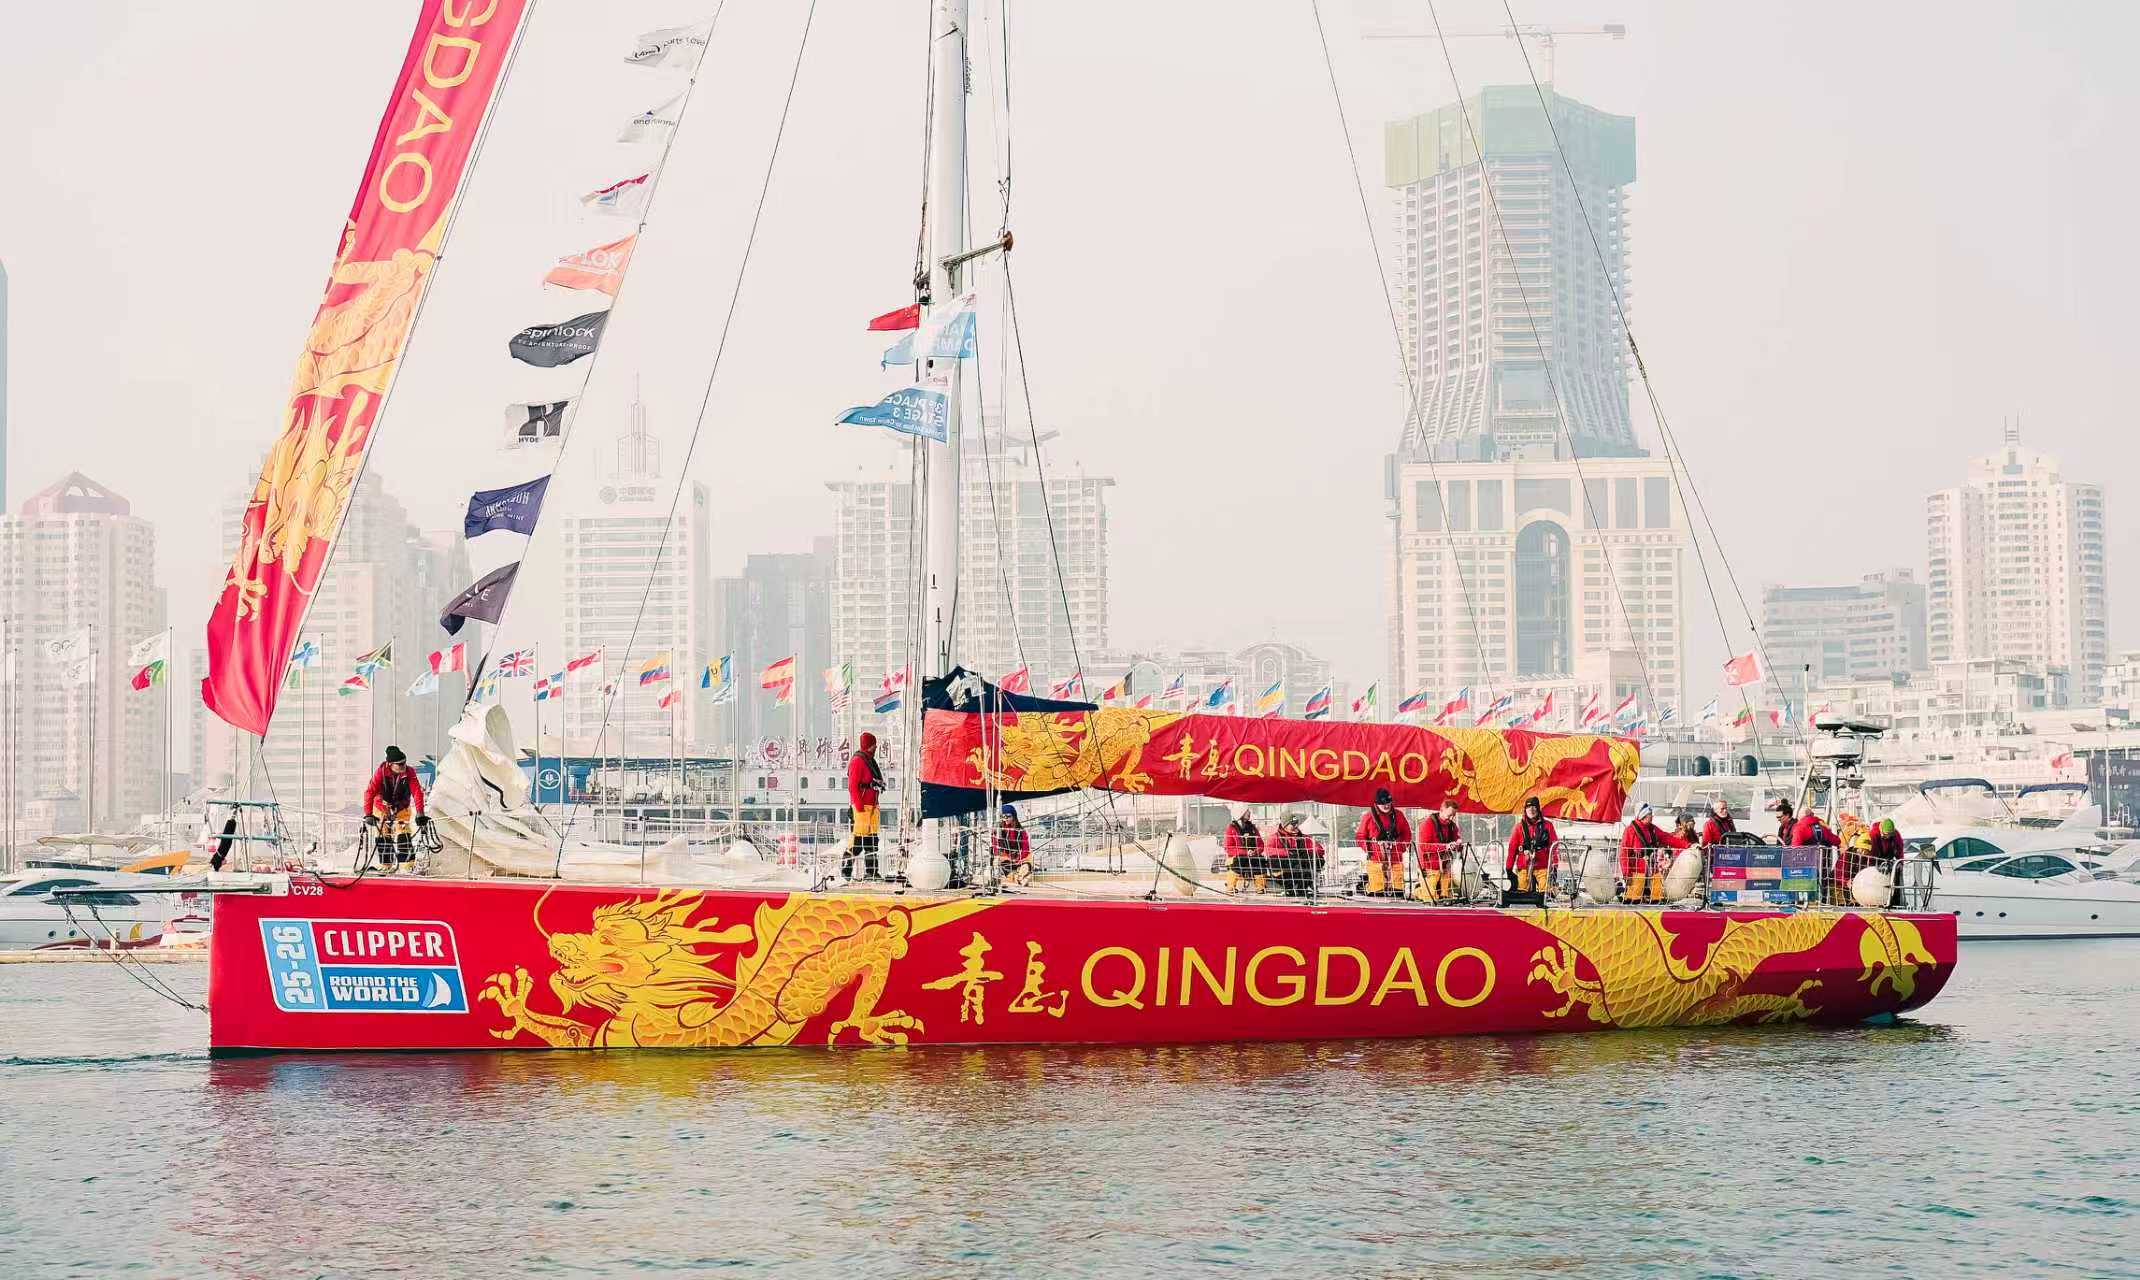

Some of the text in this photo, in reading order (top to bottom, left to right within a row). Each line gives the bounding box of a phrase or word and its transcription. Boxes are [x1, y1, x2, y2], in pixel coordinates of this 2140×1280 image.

[521, 326, 596, 339] spinlock
[1233, 744, 1429, 784] QINGDAO
[293, 885, 324, 896] CV28
[324, 929, 445, 958] CLIPPER
[271, 926, 316, 1004] 25-26
[329, 975, 418, 987] ROUND THE
[1081, 946, 1496, 1009] QINGDAO
[331, 986, 420, 1003] WORLD
